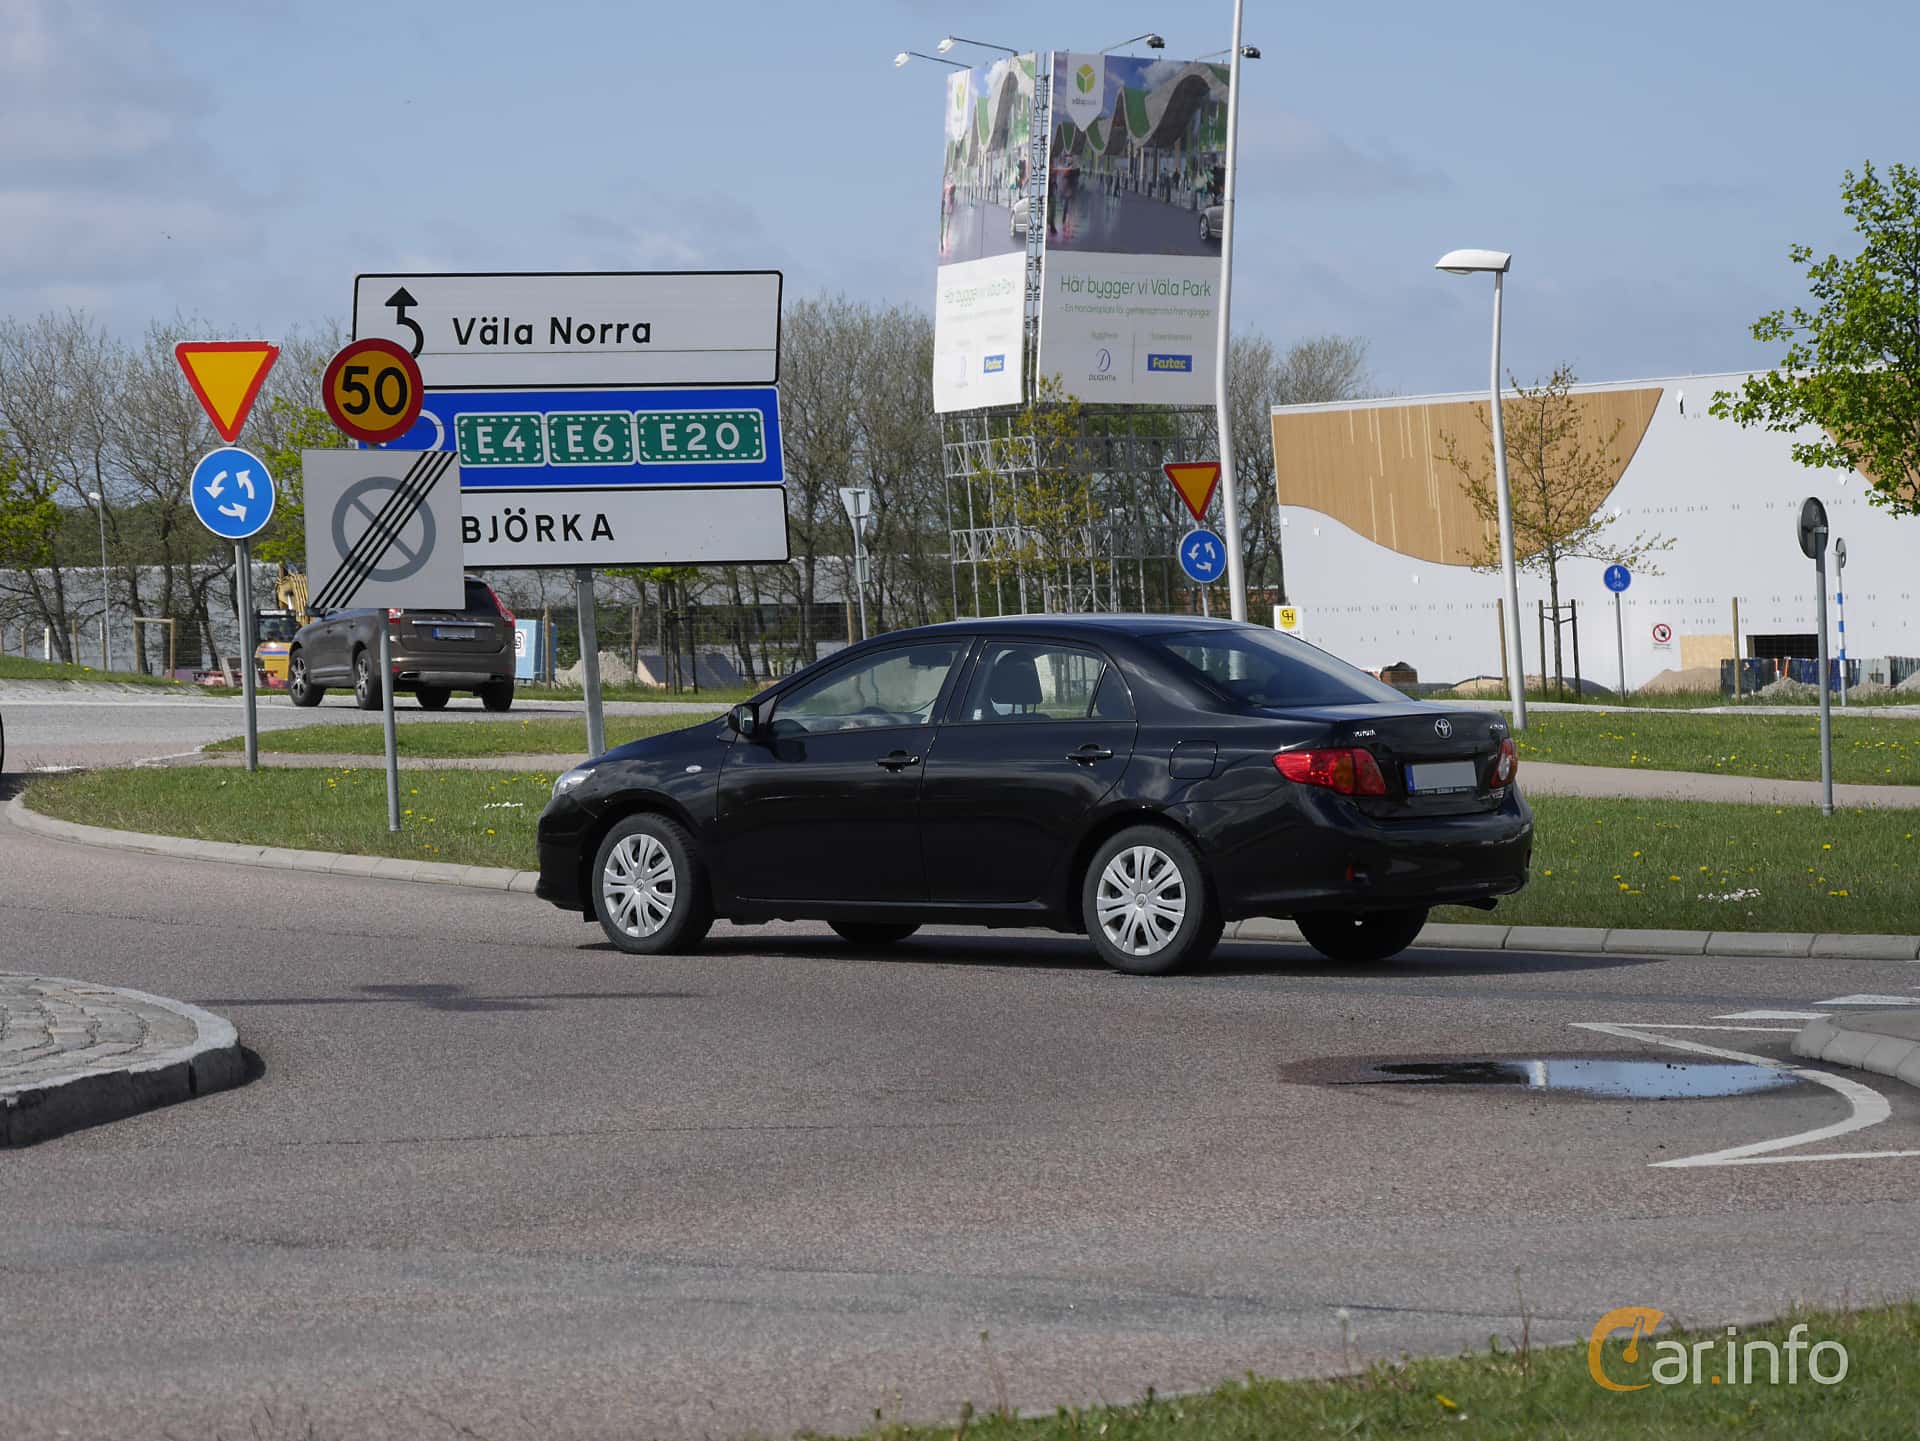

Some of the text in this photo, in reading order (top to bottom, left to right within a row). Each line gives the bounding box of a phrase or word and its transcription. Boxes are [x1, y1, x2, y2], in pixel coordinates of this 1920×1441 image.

[1060, 275, 1211, 299] Här bygger vi Väla Park
[452, 316, 650, 345] Väla Norra
[342, 366, 407, 415] 50
[476, 422, 740, 454] E4 E6 E20
[461, 507, 615, 544] BJÖRKA
